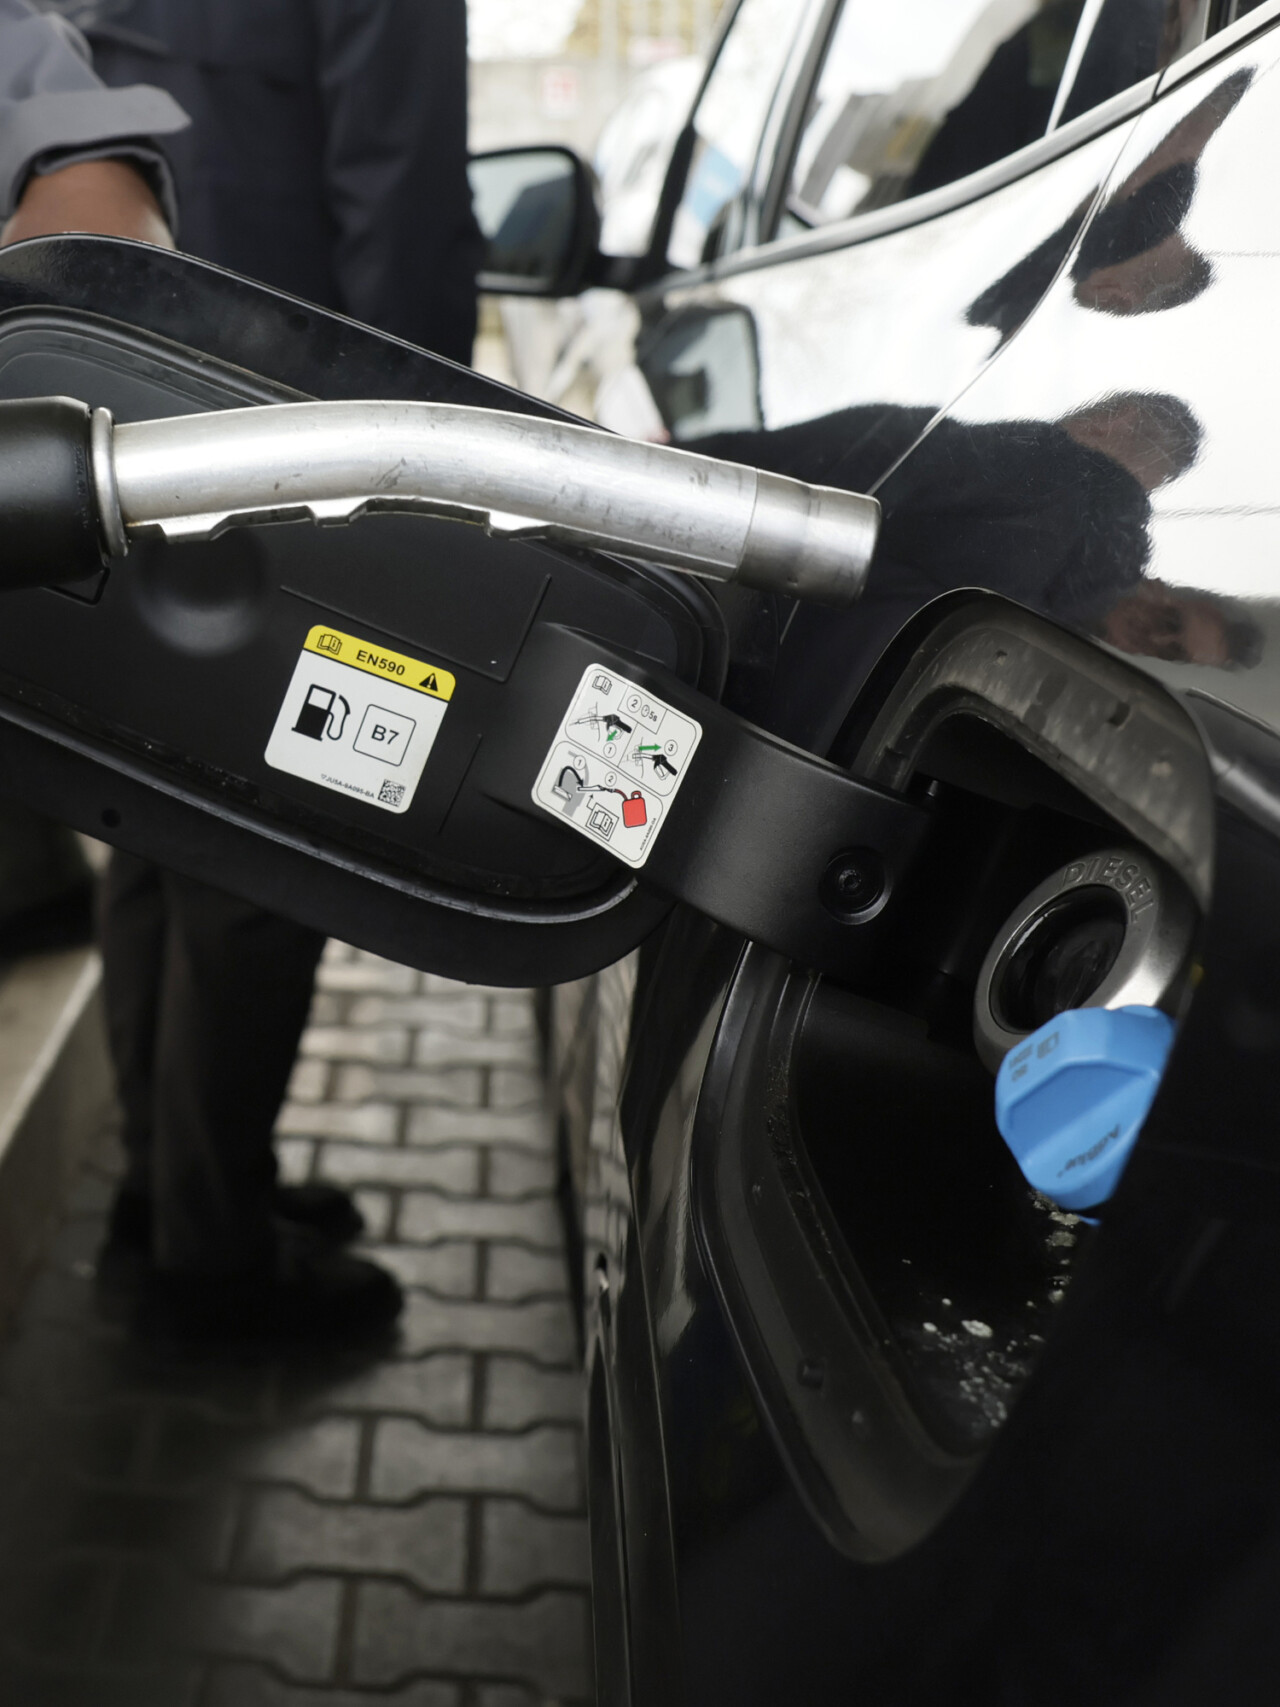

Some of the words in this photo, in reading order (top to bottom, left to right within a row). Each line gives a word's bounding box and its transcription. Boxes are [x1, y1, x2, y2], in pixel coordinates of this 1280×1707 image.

[355, 650, 407, 676] EN590
[371, 724, 400, 745] B7
[1062, 856, 1155, 925] DIESEL
